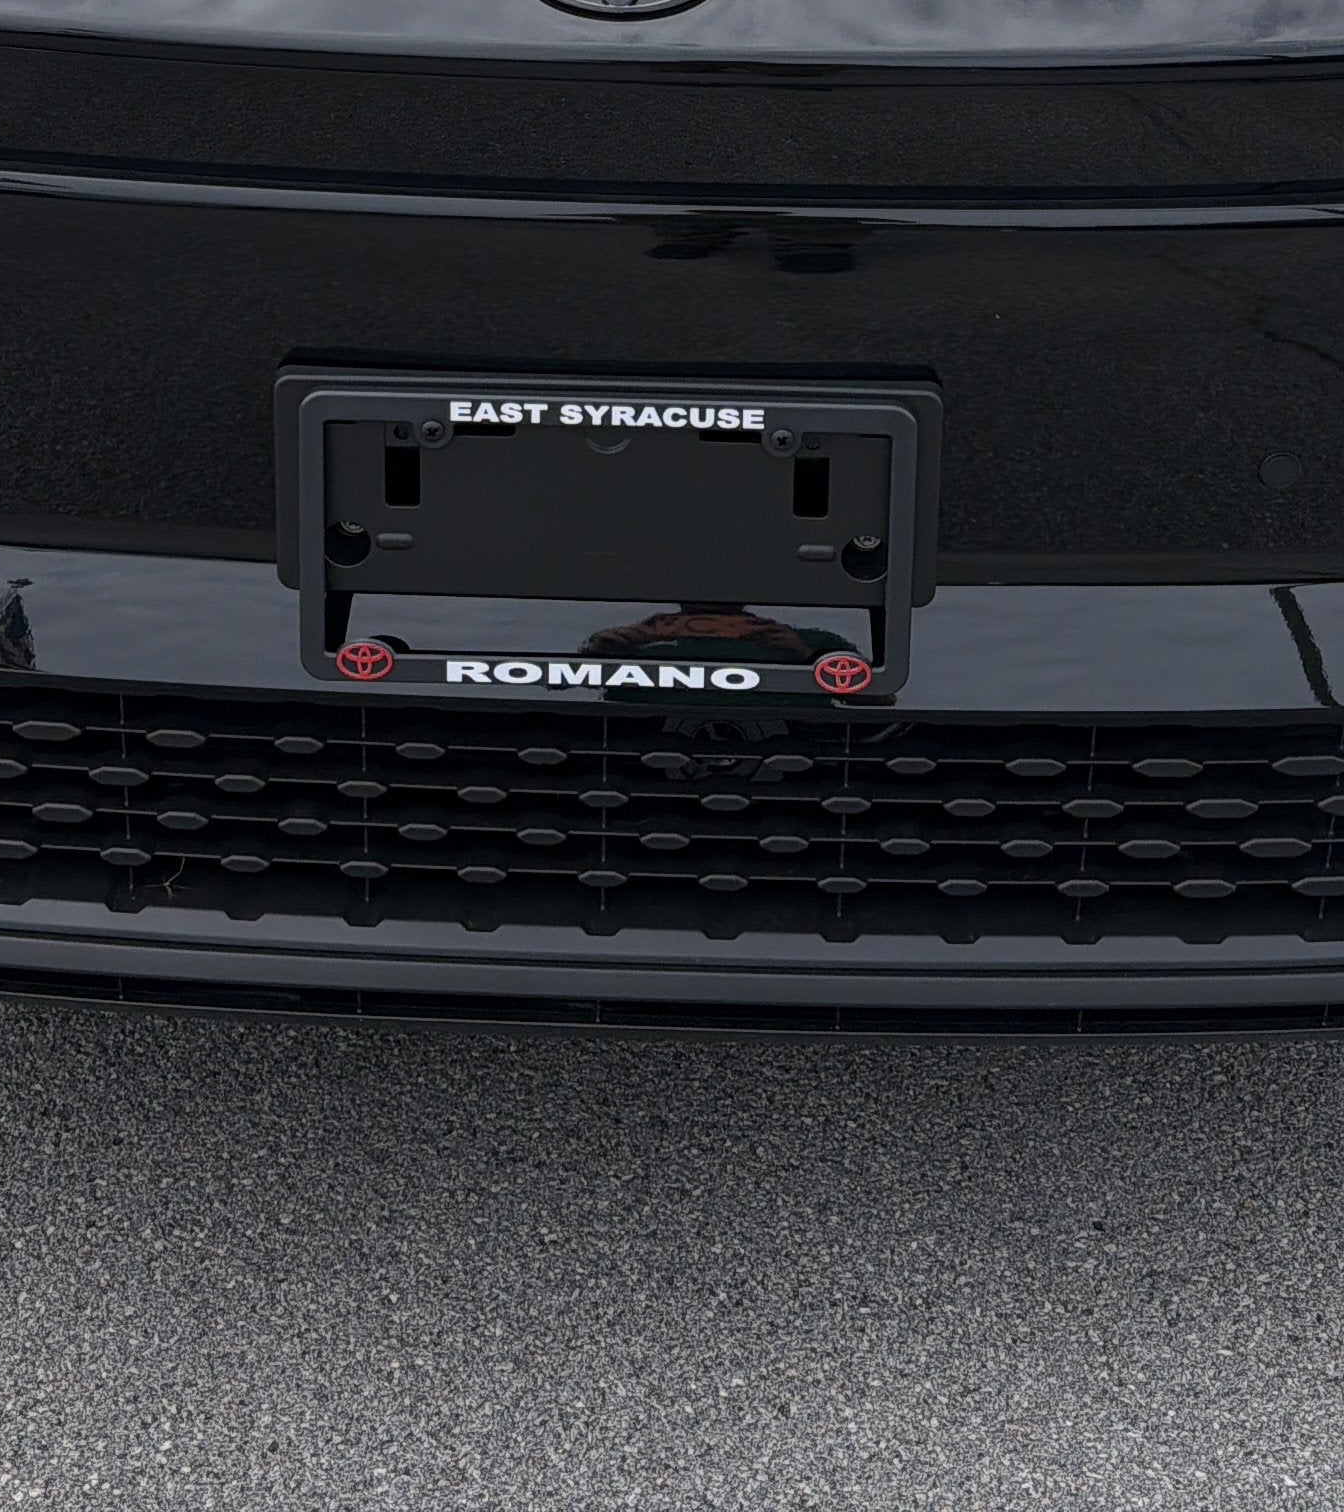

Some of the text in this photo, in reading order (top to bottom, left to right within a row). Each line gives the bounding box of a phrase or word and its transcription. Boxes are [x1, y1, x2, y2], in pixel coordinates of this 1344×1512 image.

[449, 400, 766, 430] EAST SYRACUSE
[446, 660, 761, 690] ROMANO
